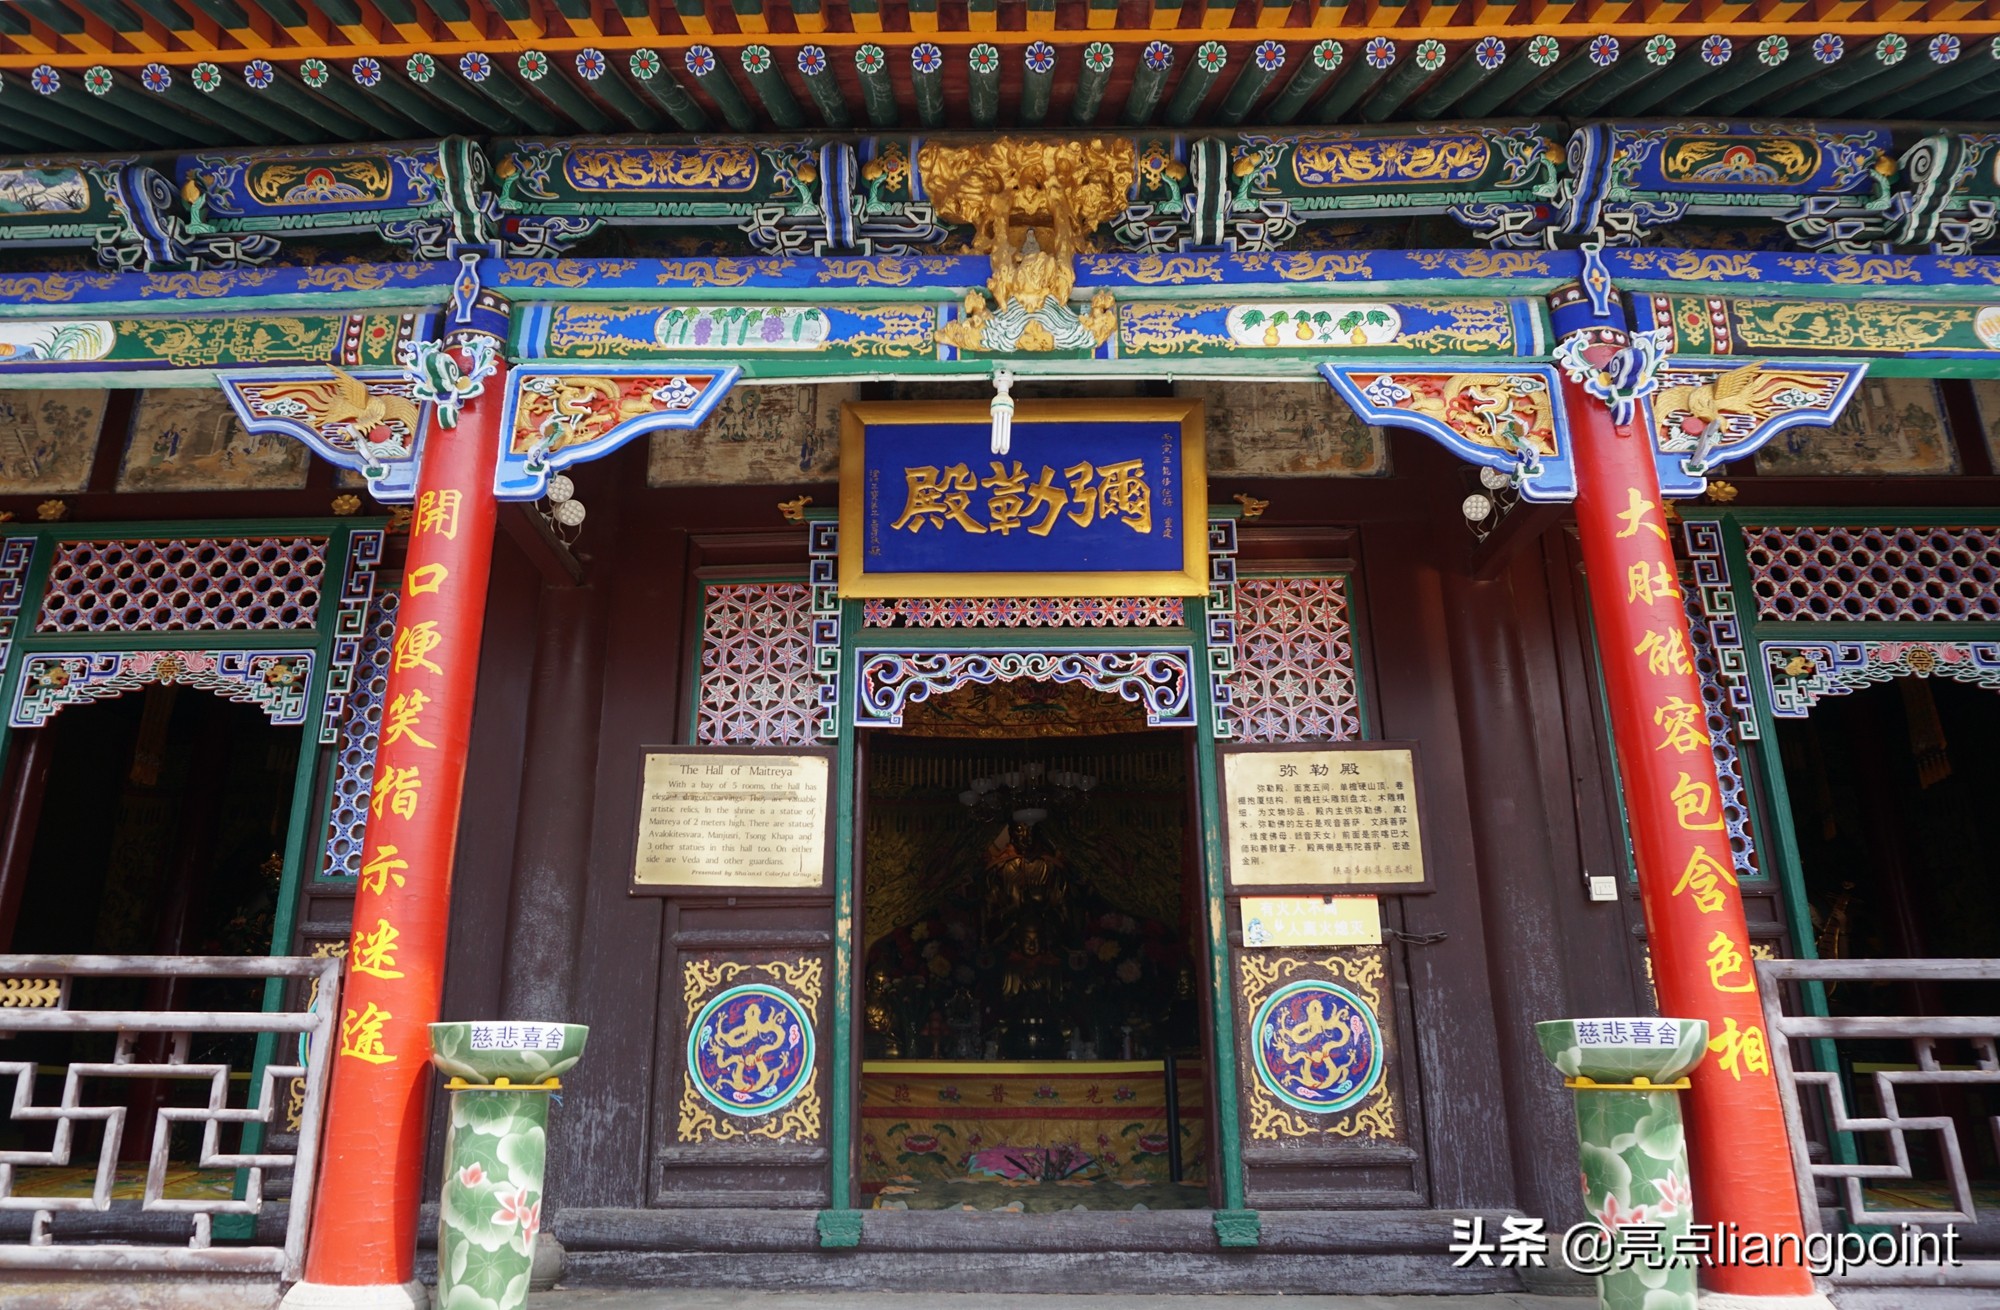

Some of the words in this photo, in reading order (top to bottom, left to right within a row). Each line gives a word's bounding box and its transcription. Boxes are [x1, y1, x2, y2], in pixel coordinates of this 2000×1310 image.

[680, 764, 699, 775] The
[706, 764, 723, 775] Hall
[731, 765, 742, 776] of
[750, 766, 793, 777] Maitreya
[1279, 763, 1360, 777] 弥勒殿
[340, 489, 463, 1067] 開口便笑指示迷途
[668, 780, 686, 789] With
[700, 781, 714, 790] bay
[719, 781, 727, 789] of
[732, 782, 737, 790] 5
[770, 782, 783, 790] the
[787, 782, 800, 790] hall
[805, 782, 817, 791] has
[1616, 487, 1769, 1082] 大肚能容包含色相
[651, 805, 675, 813] artistic
[704, 805, 712, 813] In
[716, 806, 729, 814] the
[735, 806, 755, 815] shrine
[760, 806, 765, 814] is
[779, 807, 802, 815] statue
[649, 817, 681, 827] Maitreya
[683, 817, 692, 826] of
[693, 818, 699, 826] 2
[749, 819, 770, 827] There
[788, 820, 814, 828] statues
[745, 831, 766, 842] Tsong
[771, 832, 794, 842] Khapa
[799, 832, 812, 840] and
[654, 843, 674, 851] other
[722, 844, 735, 852] this
[740, 844, 753, 852] hall
[791, 845, 813, 853] either
[646, 855, 660, 863] side
[682, 856, 700, 864] Veda
[705, 856, 719, 864] and
[723, 856, 744, 865] other
[749, 857, 784, 866] guardians.
[472, 1026, 563, 1049] 慈悲喜舍
[1577, 1021, 1677, 1045] 慈悲喜舍
